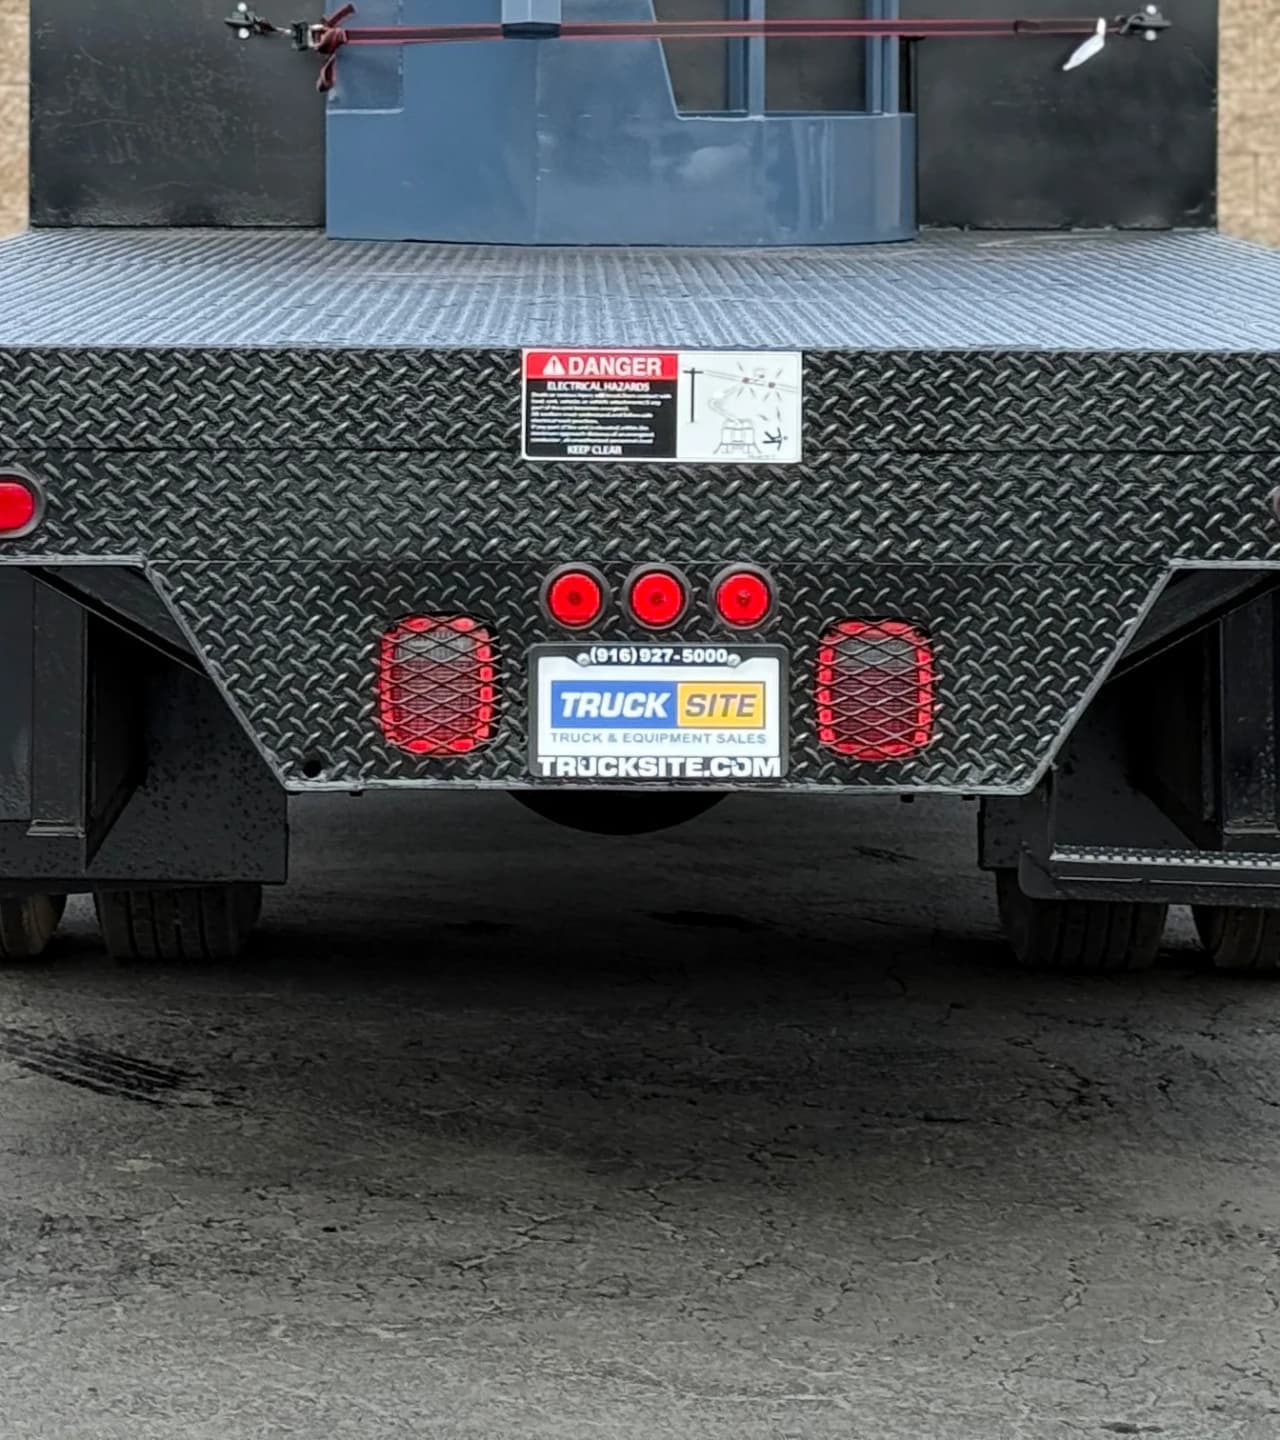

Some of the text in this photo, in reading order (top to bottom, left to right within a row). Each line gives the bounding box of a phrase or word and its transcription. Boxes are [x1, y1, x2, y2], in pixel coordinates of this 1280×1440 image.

[568, 357, 662, 377] DANGER
[547, 381, 650, 392] ELECTRICAL HAZARDS
[567, 445, 622, 455] KEEP CLEAR
[560, 692, 757, 718] TRUCK SITE
[551, 732, 766, 744] TRUCK & EQUIPMENT SALES
[538, 756, 780, 777] TRUCKSITE.COM
